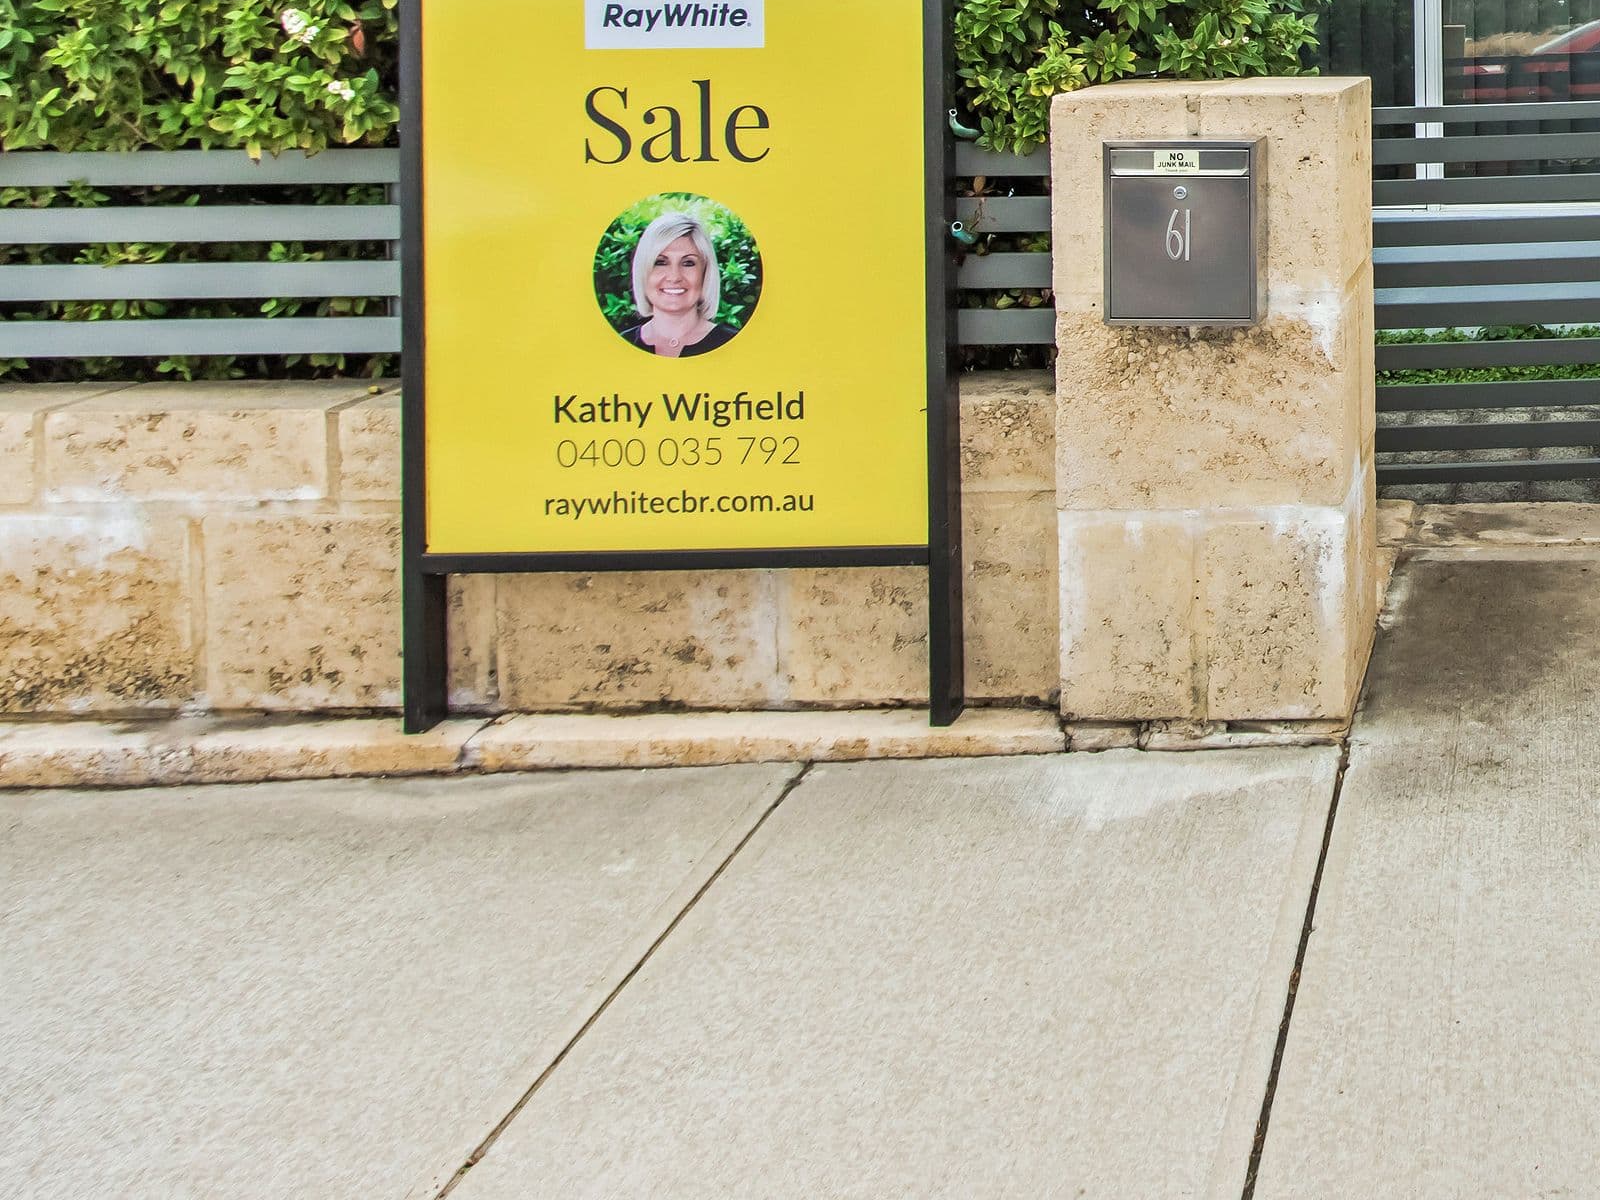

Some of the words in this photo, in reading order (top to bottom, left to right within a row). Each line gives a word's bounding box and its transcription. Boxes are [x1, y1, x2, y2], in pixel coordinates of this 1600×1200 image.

[584, 78, 771, 165] Sale
[1169, 152, 1184, 161] NO
[1165, 208, 1191, 261] 61
[554, 393, 654, 429] Kathy
[661, 390, 805, 428] Wigfield
[556, 438, 646, 469] 0400
[657, 437, 723, 467] 035
[736, 435, 801, 465] 792
[544, 489, 815, 521] raywhitecbr.com.au
